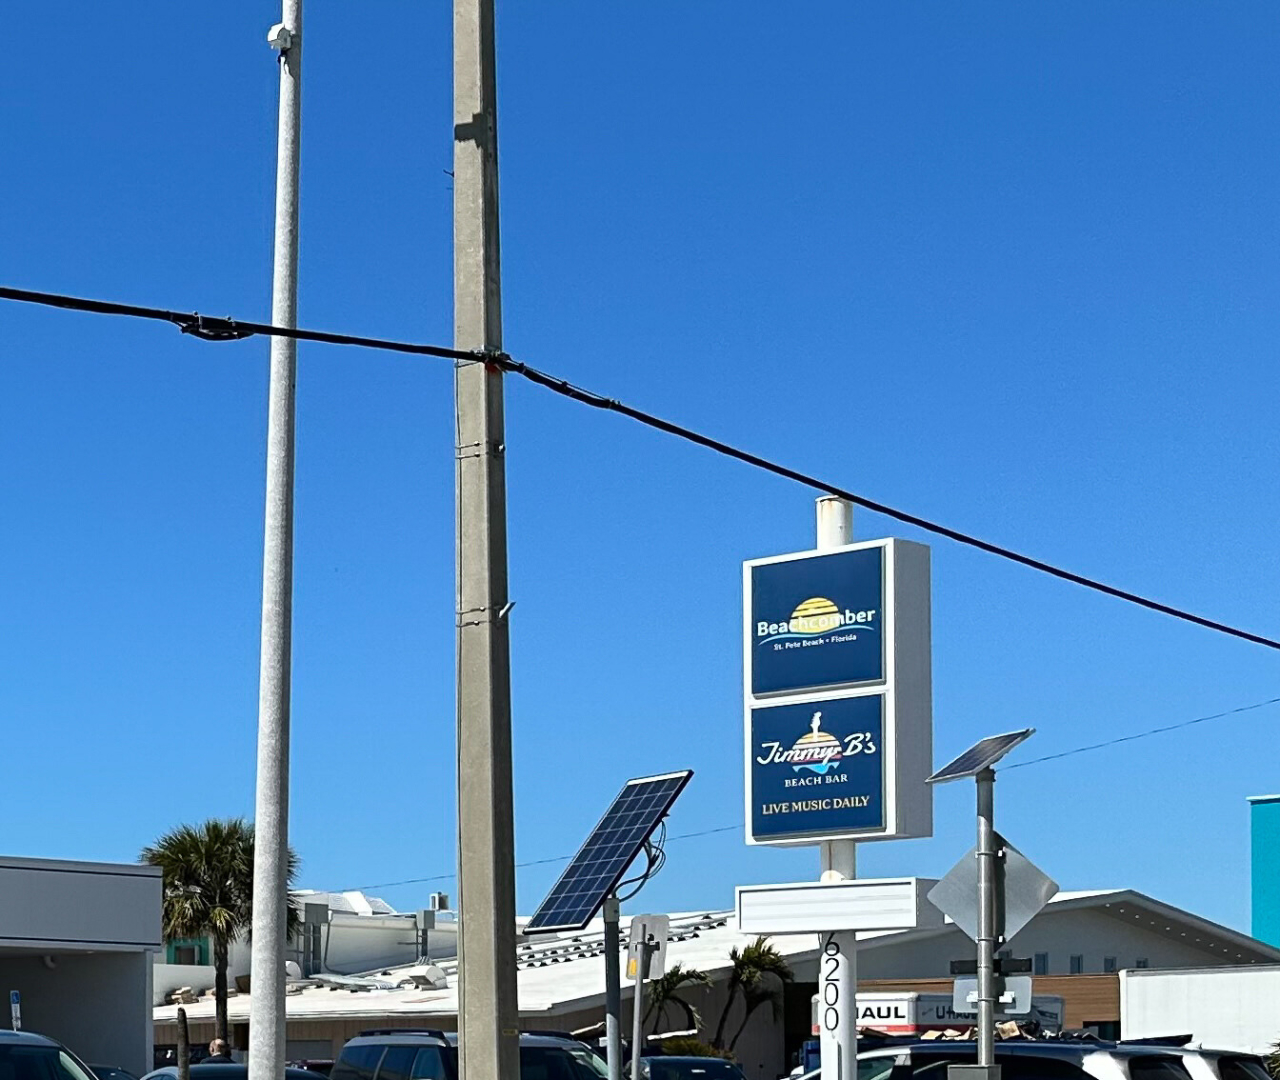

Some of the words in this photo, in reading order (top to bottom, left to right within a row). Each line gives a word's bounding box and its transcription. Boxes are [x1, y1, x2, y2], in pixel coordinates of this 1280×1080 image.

[757, 609, 876, 636] Beachcomber
[802, 638, 825, 647] Beach
[831, 633, 857, 643] Florida
[756, 741, 842, 766] Jimmy
[842, 732, 876, 756] B's
[784, 776, 822, 788] BEACH
[825, 773, 849, 784] BAR
[762, 802, 790, 815] LIVE
[791, 799, 832, 813] MUSIC
[833, 795, 870, 809] DAILY
[824, 932, 840, 1031] 6200
